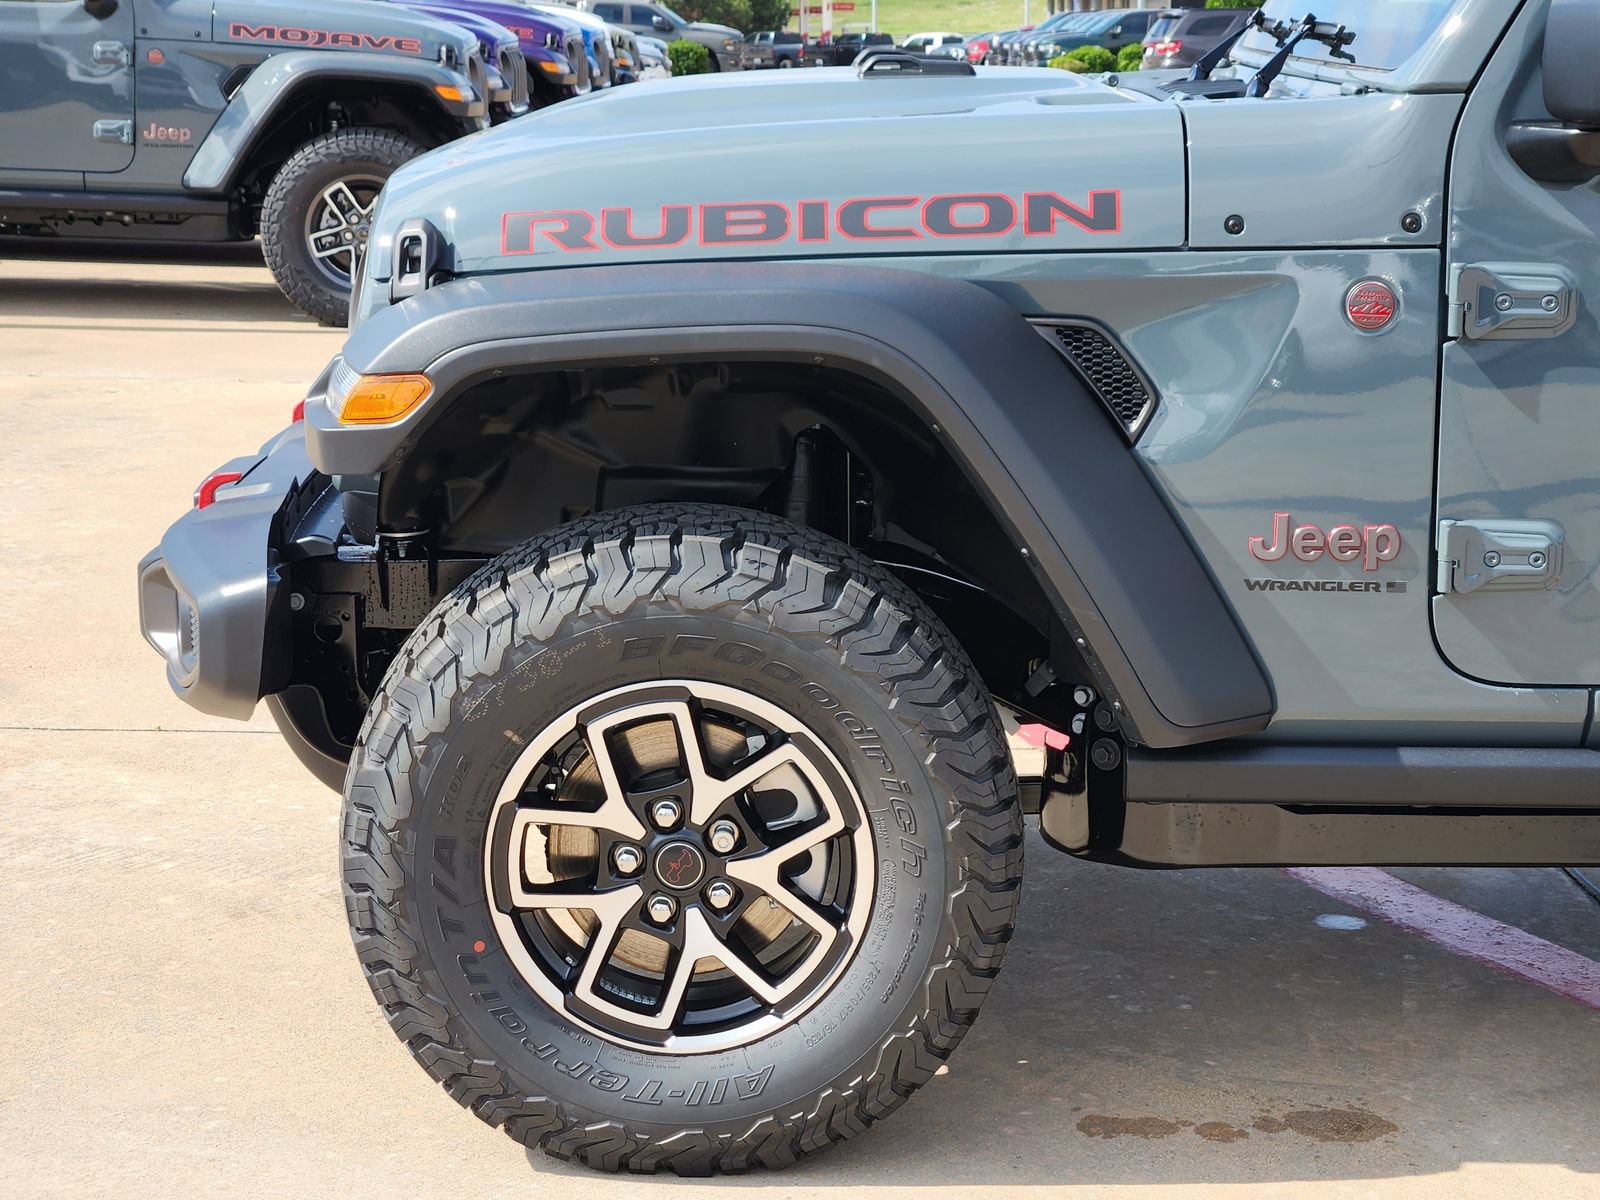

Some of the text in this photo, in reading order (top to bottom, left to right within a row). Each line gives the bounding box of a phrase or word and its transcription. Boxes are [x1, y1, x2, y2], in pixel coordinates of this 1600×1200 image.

[229, 22, 421, 53] MOJAVE
[143, 122, 192, 144] Jeep
[501, 189, 1122, 254] RUBICON
[1248, 512, 1401, 571] Jeep
[1243, 578, 1381, 593] WRANGLER
[619, 634, 929, 879] BFGoodrich
[431, 836, 465, 941] T/A
[456, 953, 775, 1105] All-Terrain
